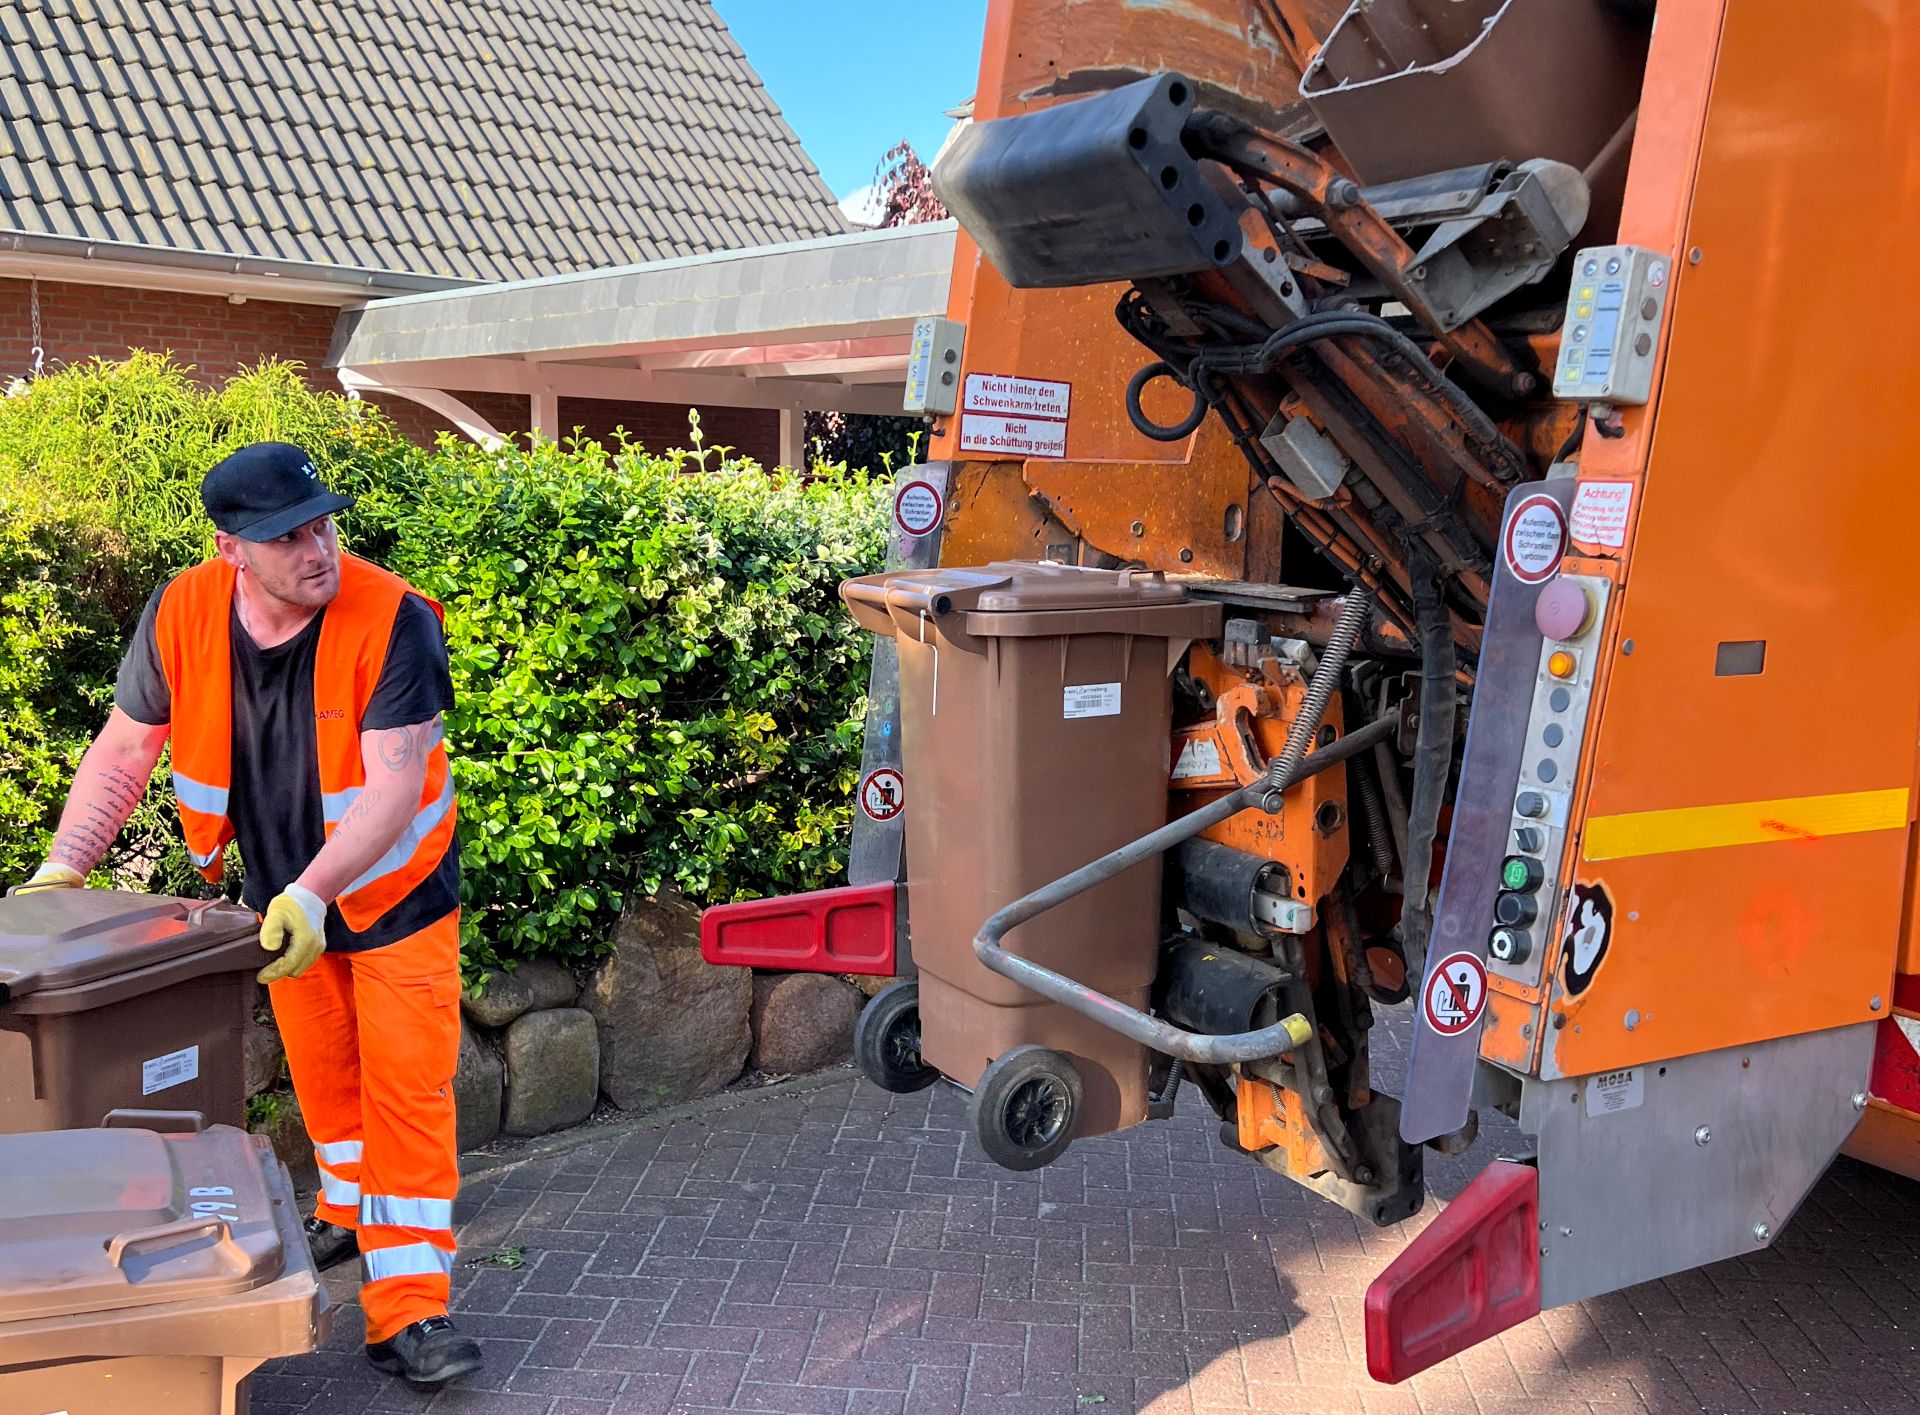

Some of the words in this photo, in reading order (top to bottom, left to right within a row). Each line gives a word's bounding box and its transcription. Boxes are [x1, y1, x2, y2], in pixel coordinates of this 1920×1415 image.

[982, 381, 1007, 393] Nicht
[1010, 382, 1037, 395] hinter
[1039, 386, 1055, 397] den
[973, 394, 1032, 409] Schwenkarm
[1034, 401, 1061, 413] treten
[1005, 422, 1027, 434] Nicht
[963, 433, 971, 443] in
[974, 434, 988, 445] die
[989, 435, 1033, 450] Schüttung
[1583, 488, 1625, 502] Achtung!
[1522, 517, 1555, 528] Aufenthalt
[1515, 529, 1546, 538] zwischen
[1518, 540, 1552, 550] Schranken
[1597, 1071, 1633, 1088] MOBA
